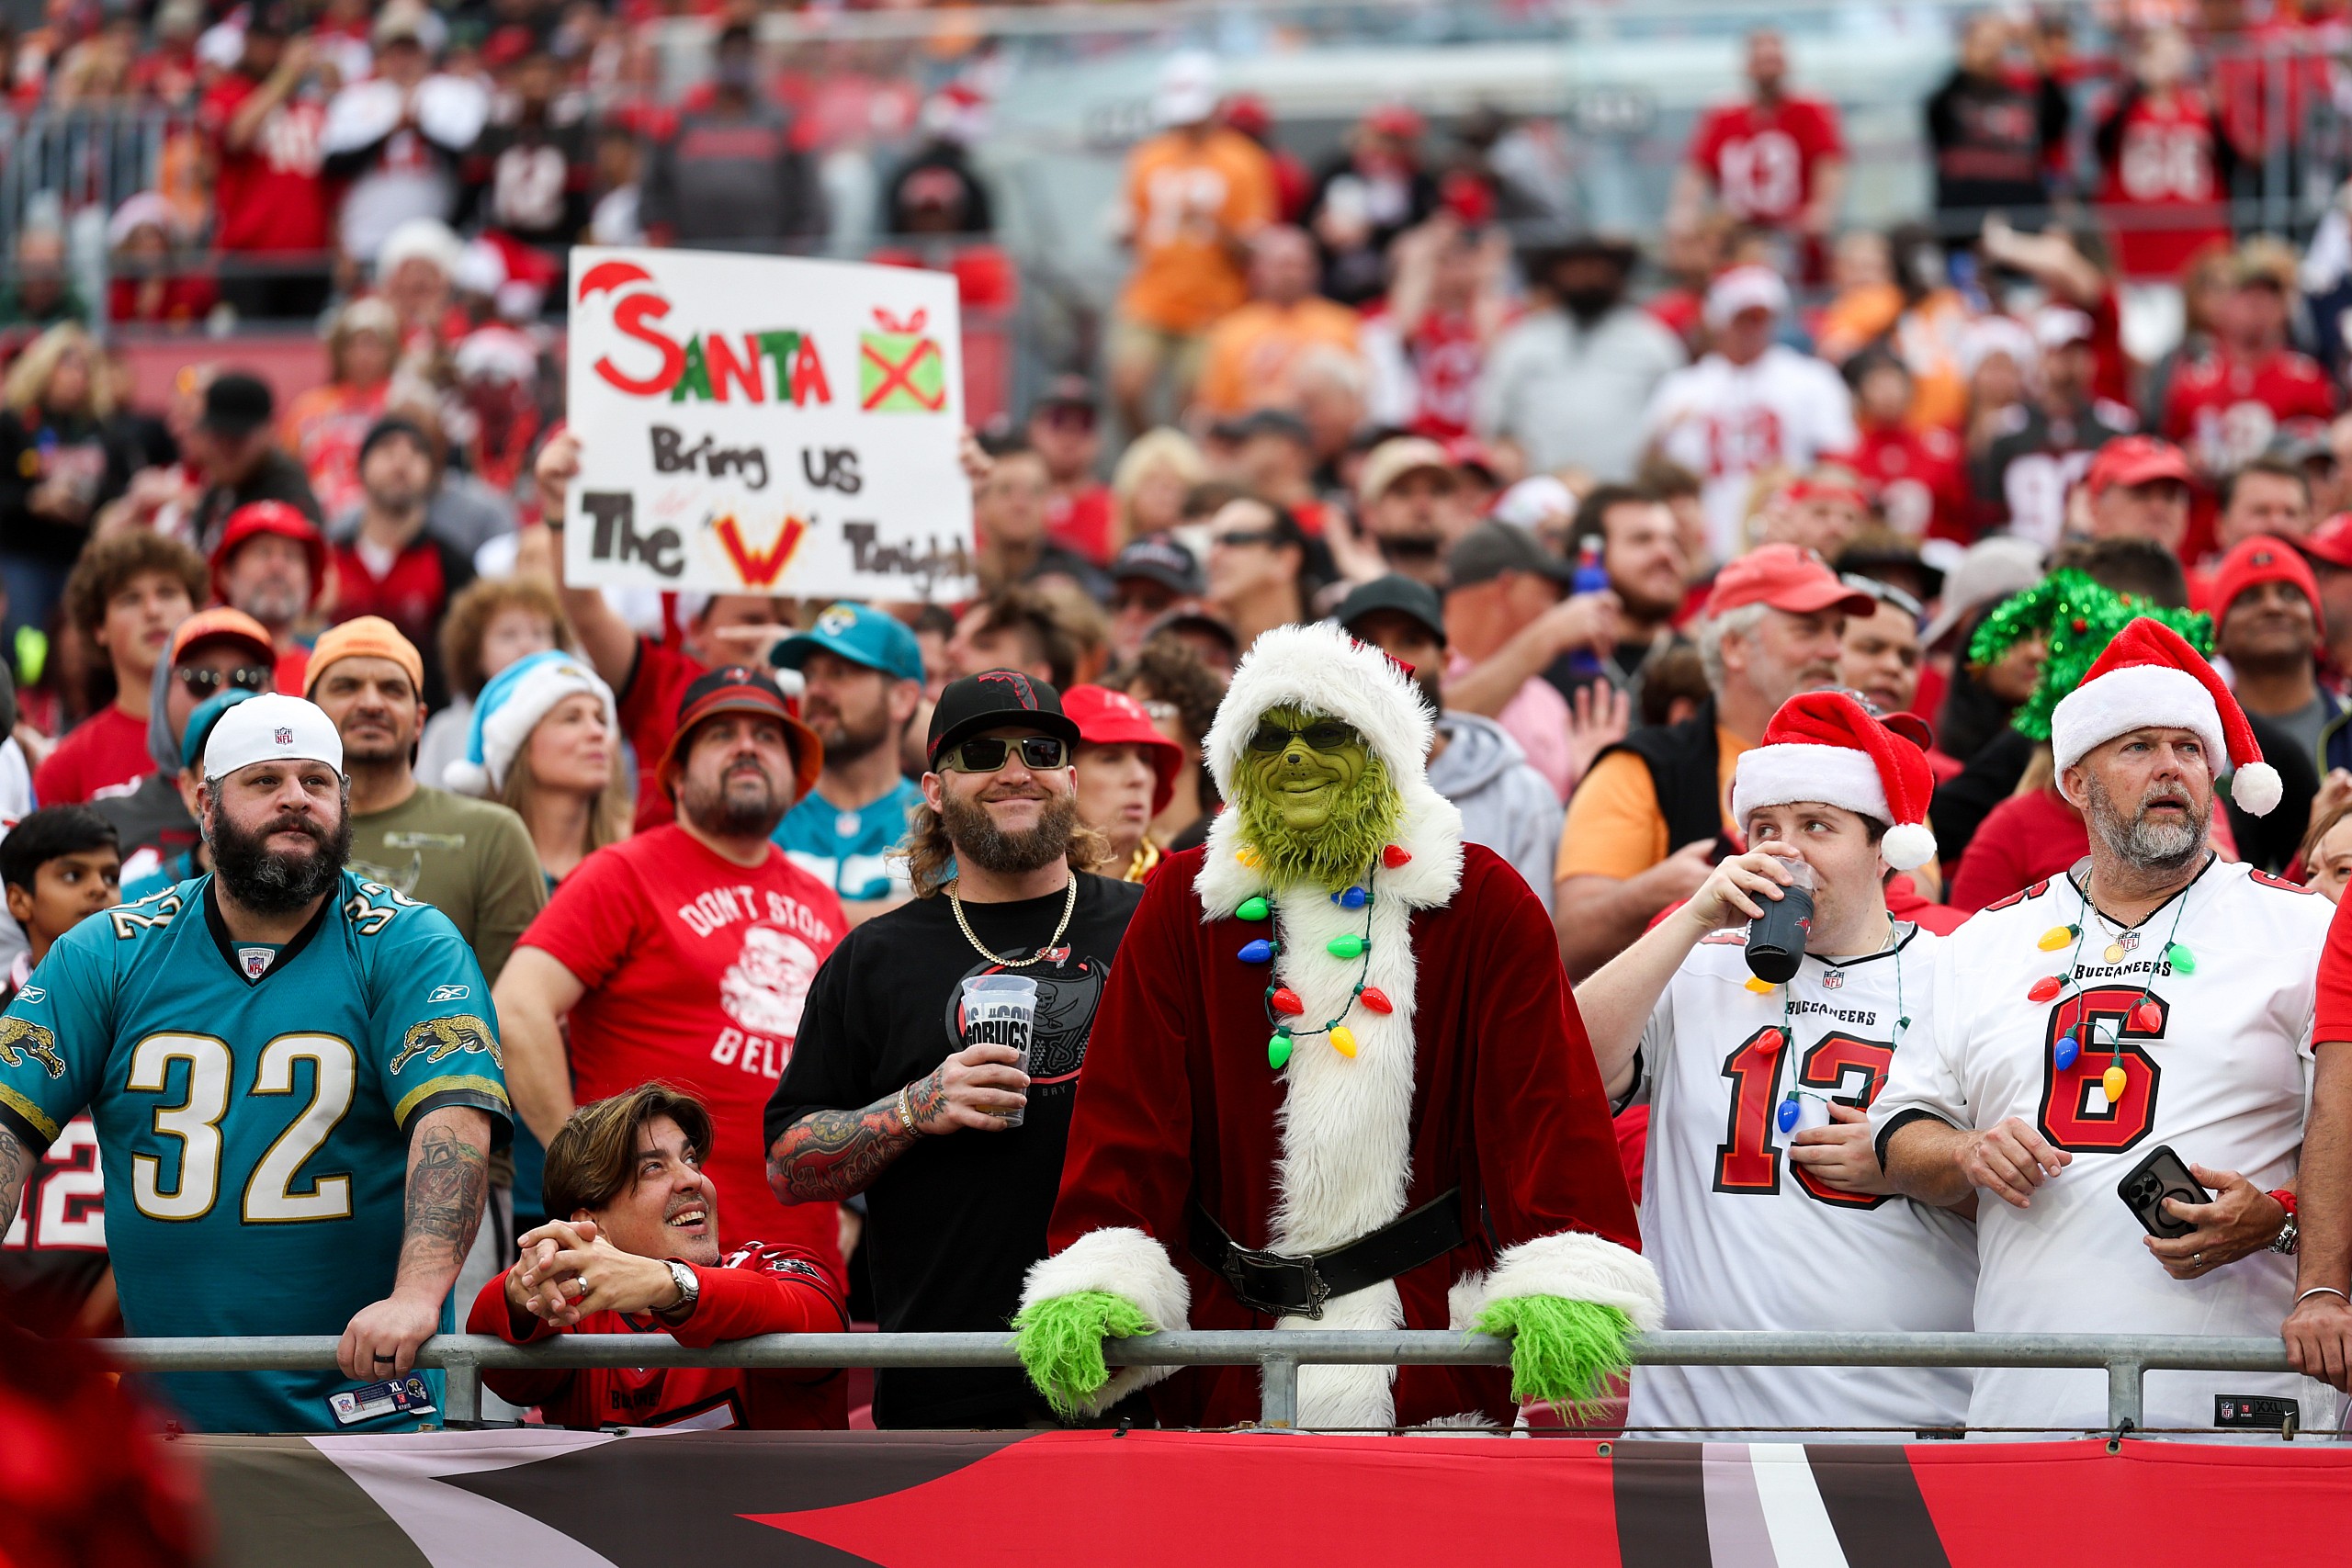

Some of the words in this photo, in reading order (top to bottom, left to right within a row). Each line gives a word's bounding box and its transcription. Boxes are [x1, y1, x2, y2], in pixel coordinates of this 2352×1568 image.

[593, 292, 832, 408] SANTA
[650, 425, 769, 491] Bring
[582, 492, 685, 579] The
[764, 890, 832, 942] STOP
[2120, 938, 2138, 950] NFL
[249, 964, 264, 975] NFL
[1824, 977, 1841, 987] NFL
[2074, 961, 2172, 980] BUCCANEERS
[1784, 1000, 1877, 1026] BUCCANEERS
[2037, 984, 2170, 1154] 6
[123, 1029, 359, 1226] 32
[388, 1381, 402, 1393] XL
[2256, 1400, 2281, 1413] XXL
